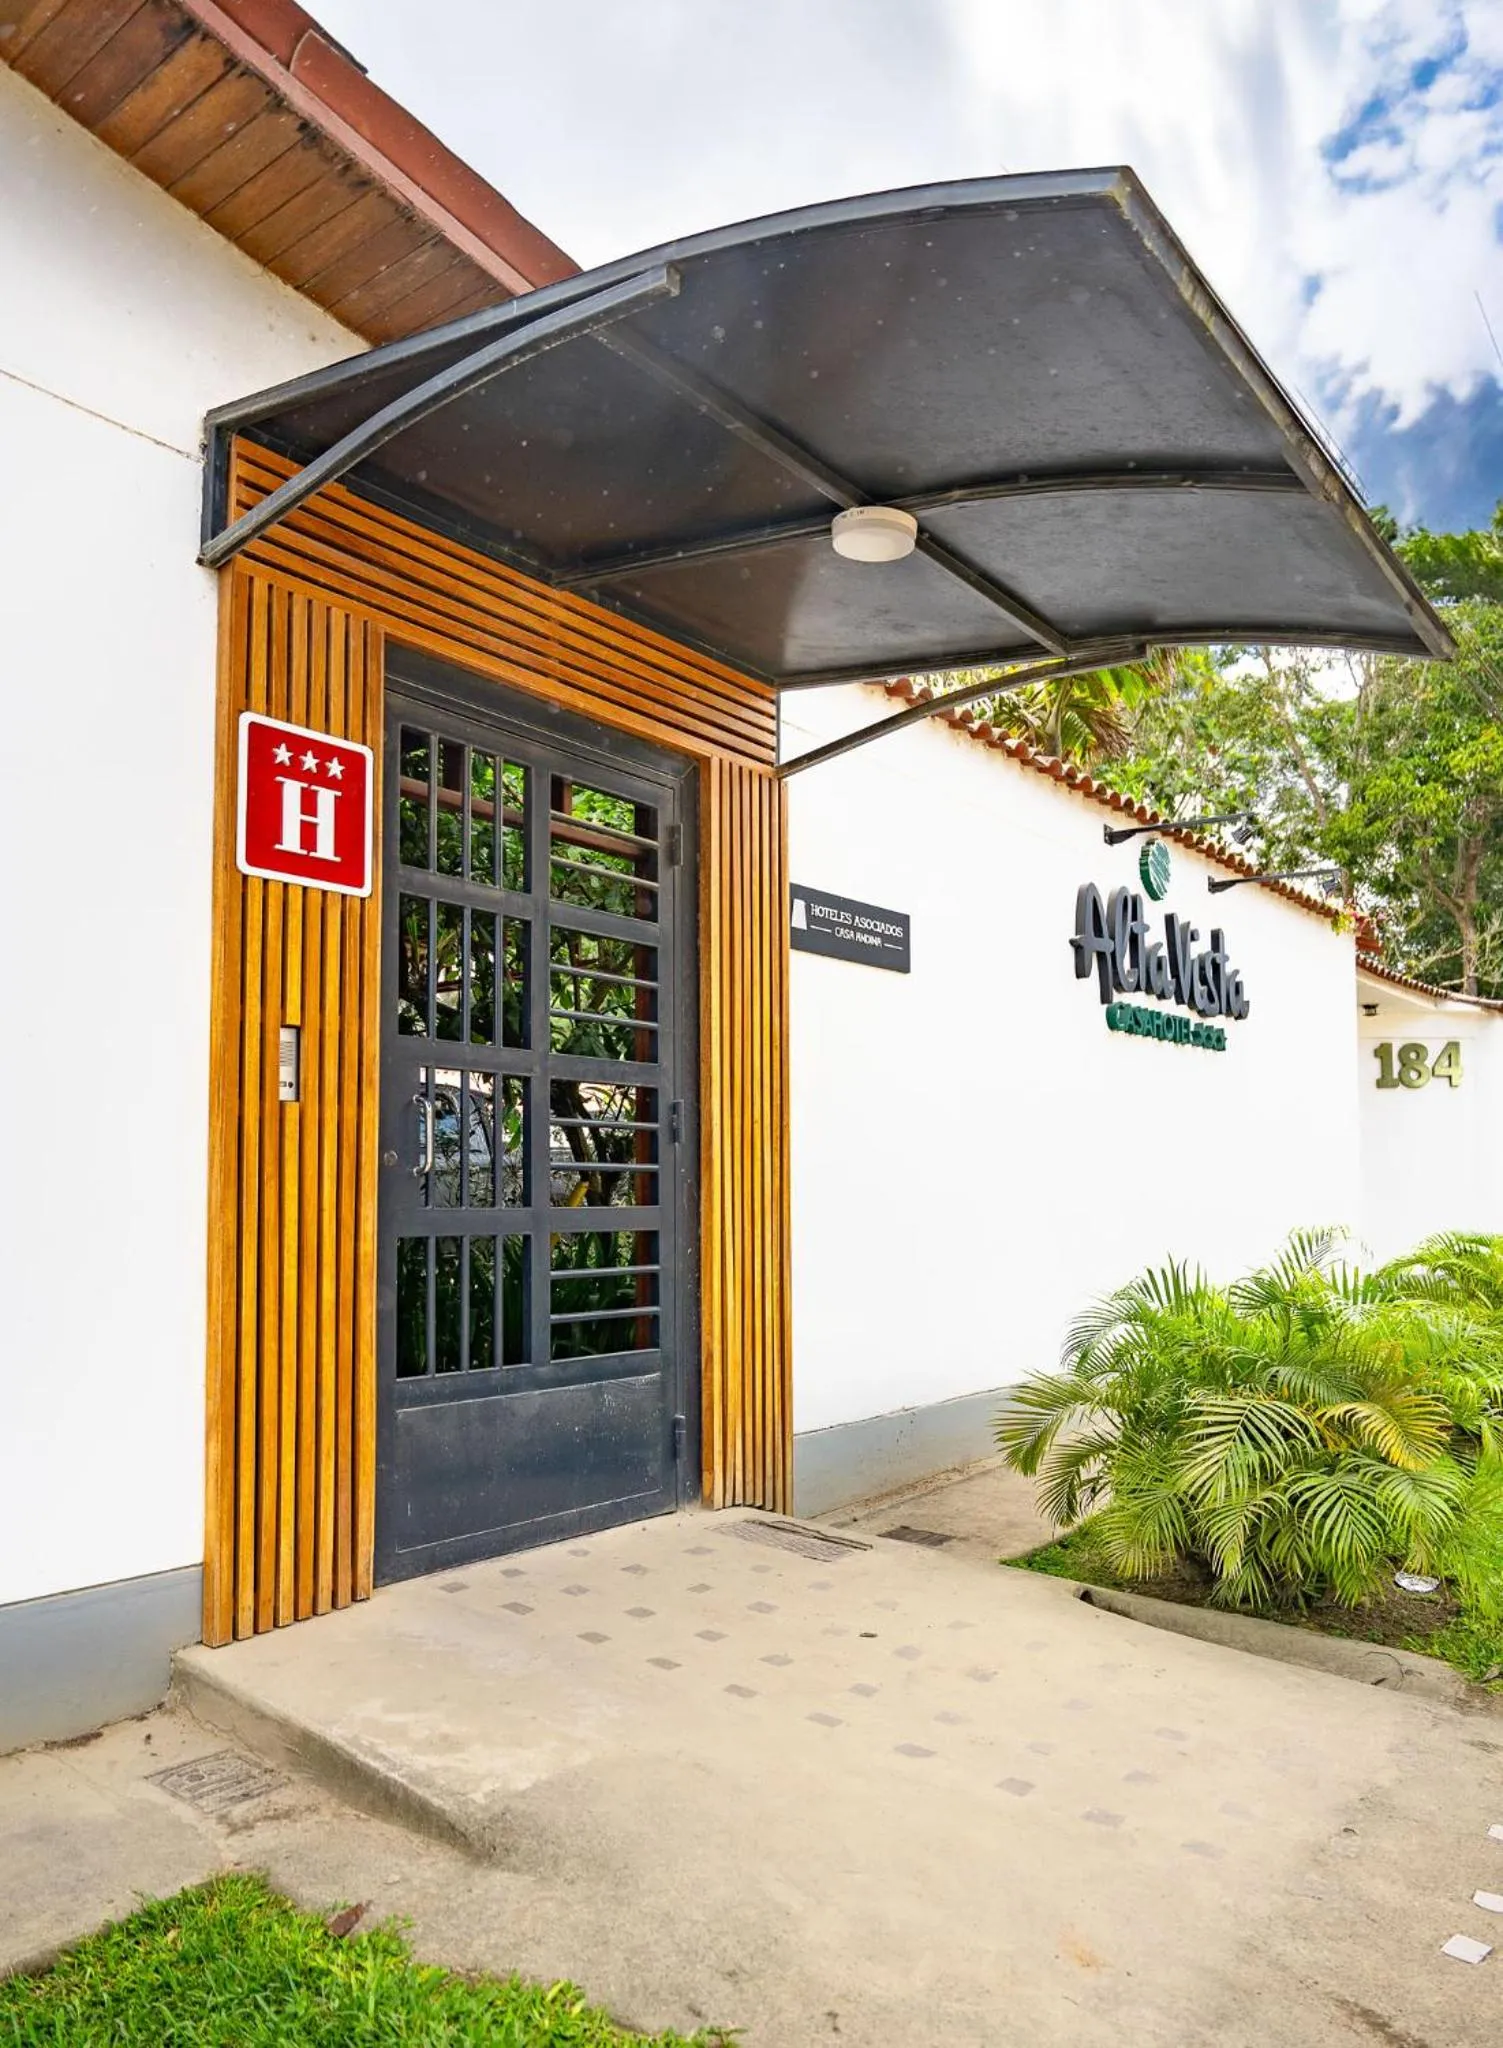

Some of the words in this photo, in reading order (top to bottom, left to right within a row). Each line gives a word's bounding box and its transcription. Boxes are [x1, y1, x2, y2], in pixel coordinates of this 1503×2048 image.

[274, 776, 342, 862] H
[810, 903, 852, 925] HOTELES
[854, 915, 904, 938] ASOCIADOS
[834, 927, 855, 941] CASA
[1373, 1041, 1463, 1089] 184
